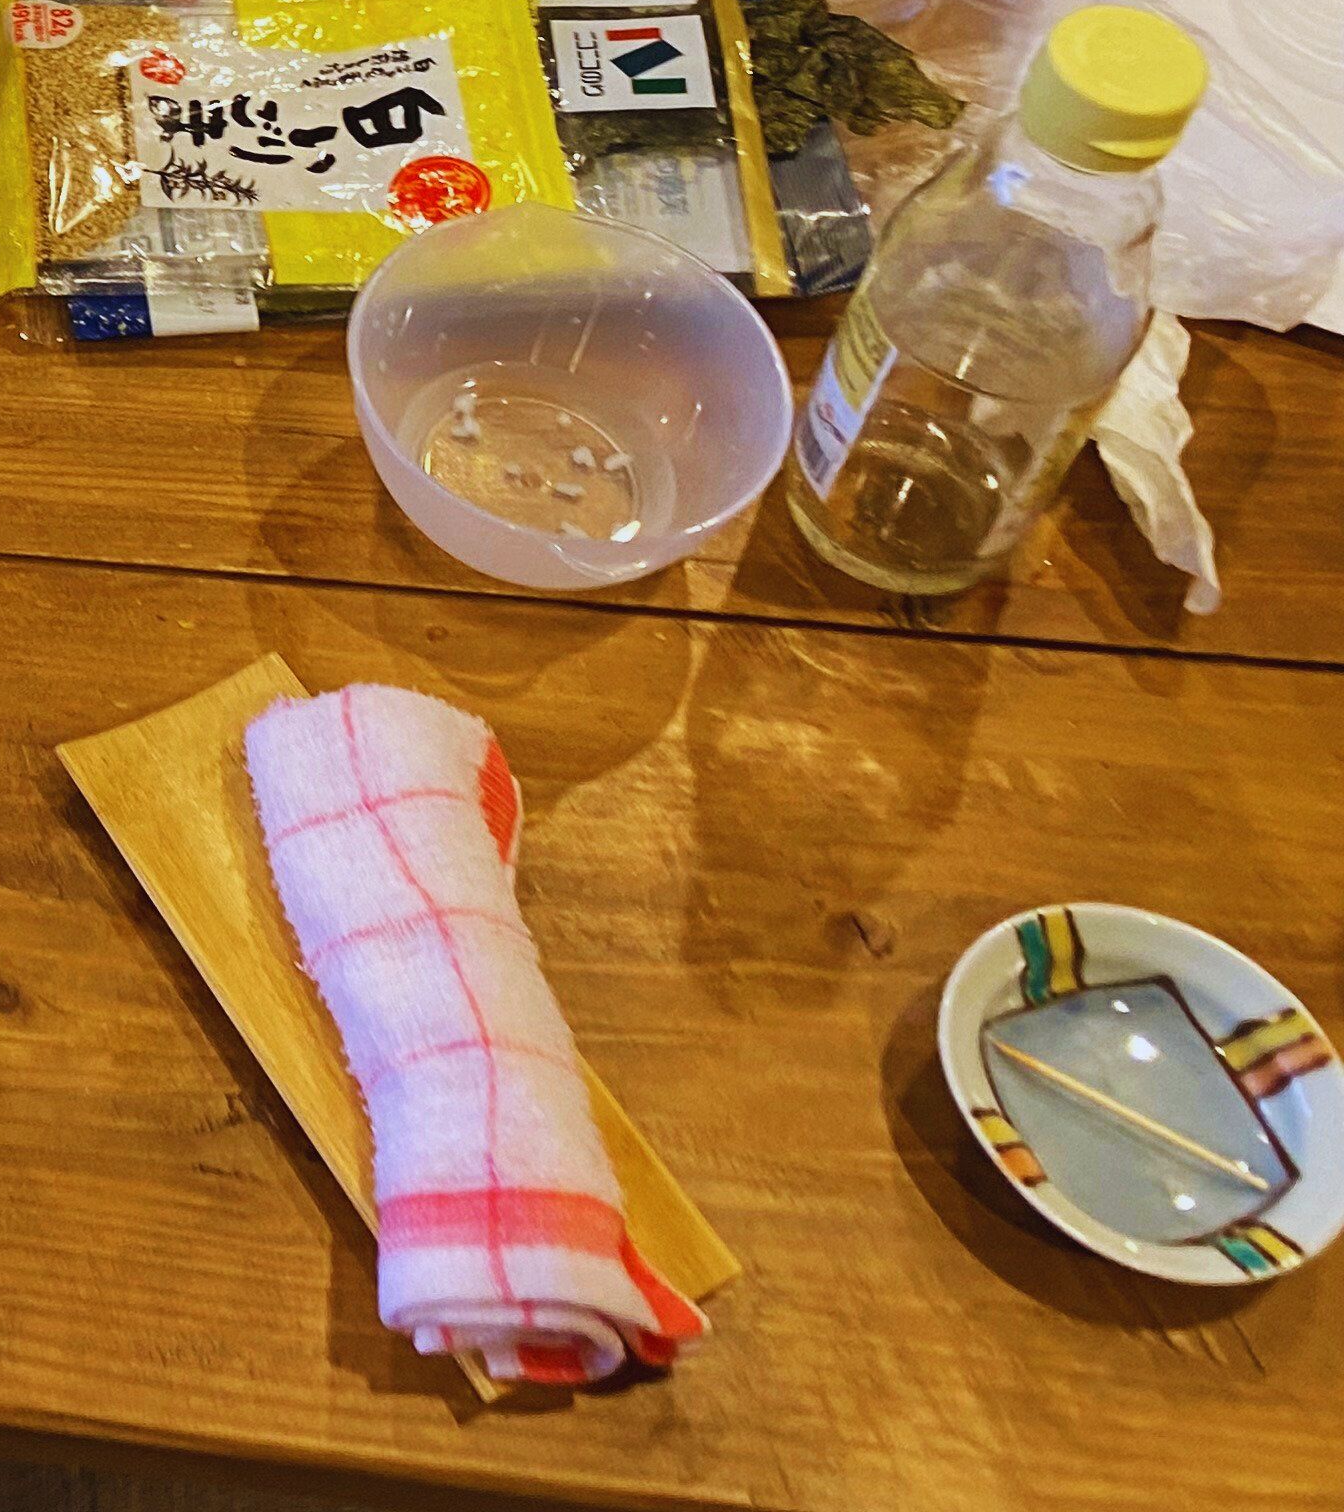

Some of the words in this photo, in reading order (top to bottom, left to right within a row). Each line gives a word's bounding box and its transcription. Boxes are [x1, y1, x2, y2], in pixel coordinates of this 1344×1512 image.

[49, 8, 75, 38] 82g
[573, 30, 605, 98] ニコニコのり
[146, 86, 447, 174] 白いりごま
